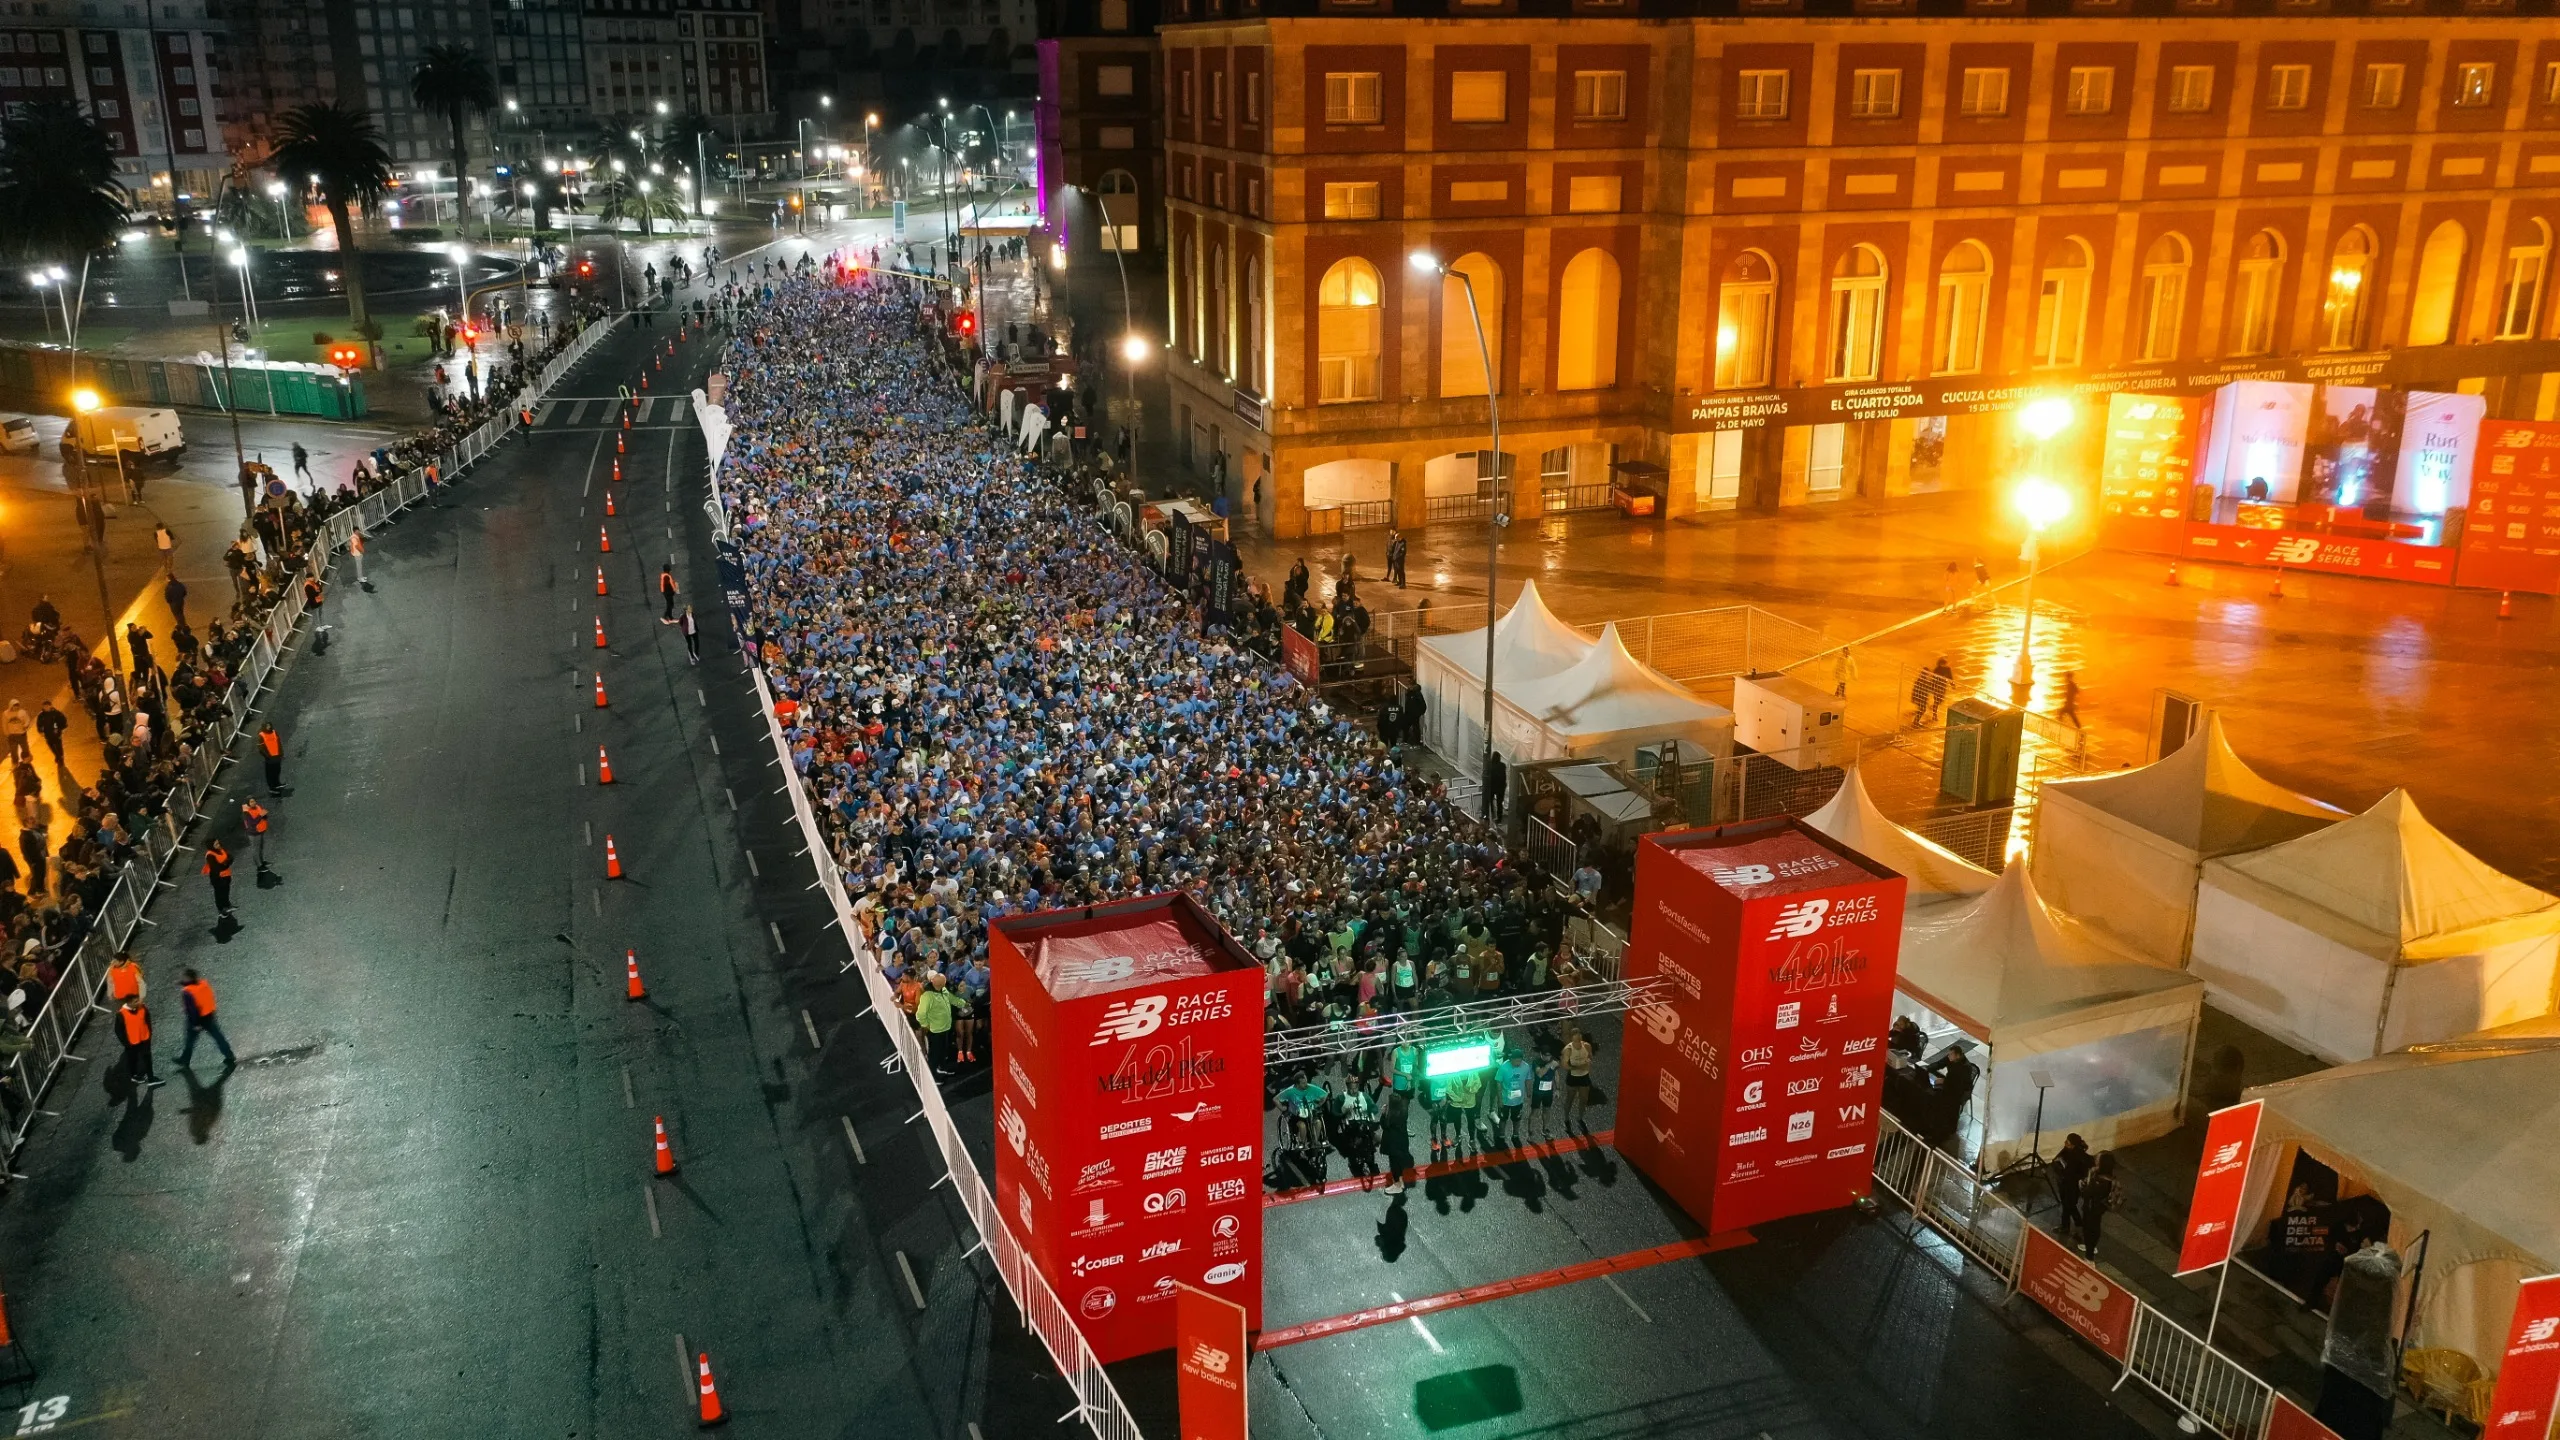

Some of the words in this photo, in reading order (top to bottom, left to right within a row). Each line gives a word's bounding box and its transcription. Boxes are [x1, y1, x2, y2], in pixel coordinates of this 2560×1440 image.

[2188, 374, 2231, 386] VIRGINIA
[2233, 370, 2285, 381] INNOCENTI
[2307, 366, 2332, 378] GALA
[2334, 365, 2348, 376] DE
[2349, 363, 2384, 375] BALLET
[2131, 377, 2177, 389] CABRERA
[1831, 400, 1844, 410] EL
[1846, 396, 1891, 409] CUARTO
[1893, 394, 1924, 406] SODA
[1942, 391, 1985, 403] CUCUZA
[1692, 406, 1740, 419] PAMPAS
[1743, 403, 1788, 416] BRAVAS
[1865, 411, 1875, 419] DE
[1877, 409, 1899, 418] JULIO
[1728, 420, 1739, 428] DE
[1741, 419, 1765, 427] MAYO
[2425, 432, 2458, 448] Run
[1175, 527, 1183, 575] DEPORTES
[2324, 544, 2360, 556] RACE
[2316, 554, 2361, 567] SERIES
[1215, 560, 1225, 609] DEPORTES
[1778, 855, 1825, 870] RACE
[1780, 860, 1840, 878] SERIES
[1835, 896, 1876, 913] RACE
[1658, 900, 1710, 944] Sportsfacilities
[1827, 909, 1878, 927] SERIES
[1142, 948, 1216, 973] SERIES
[1145, 943, 1201, 963] RACE
[1659, 952, 1702, 991] DEPORTES
[1780, 936, 1860, 994] 42k
[1176, 990, 1228, 1010] RACE
[1168, 1005, 1232, 1027] SERIES
[1777, 1016, 1798, 1025] PLATA
[1684, 1027, 1717, 1061] RACE
[1844, 1037, 1878, 1052] Hertz
[1677, 1040, 1719, 1079] SERIES
[1741, 1046, 1774, 1063] OHS
[1112, 1035, 1215, 1103] 42k
[1787, 1076, 1823, 1094] ROBY
[1736, 1102, 1767, 1112] GATORADE
[1839, 1103, 1866, 1122] VN
[1100, 1117, 1151, 1134] DEPORTES
[1791, 1121, 1811, 1130] N26
[1730, 1127, 1767, 1146] amanda
[1200, 1145, 1234, 1155] UNIVERSIDAD
[1029, 1139, 1050, 1180] RACE
[1144, 1155, 1184, 1173] BIKE
[1200, 1152, 1234, 1167] SIGLO
[1081, 1159, 1110, 1178] Sierra
[1142, 1166, 1182, 1180] opensports
[2202, 1167, 2216, 1177] new
[1026, 1153, 1052, 1201] SERIES
[1207, 1178, 1244, 1192] ULTRA
[1207, 1186, 1245, 1201] TECH
[2287, 1216, 2317, 1225] MAR
[2286, 1227, 2311, 1235] DEL
[2285, 1236, 2325, 1246] PLATA
[1085, 1254, 1124, 1270] COBER
[1207, 1270, 1237, 1280] Granix
[2030, 1280, 2056, 1304] new
[2057, 1297, 2111, 1345] balance
[2508, 1346, 2523, 1356] new
[2524, 1341, 2560, 1352] balance
[1183, 1363, 1200, 1375] new
[1201, 1369, 1237, 1390] balance
[19, 1396, 70, 1426] 13
